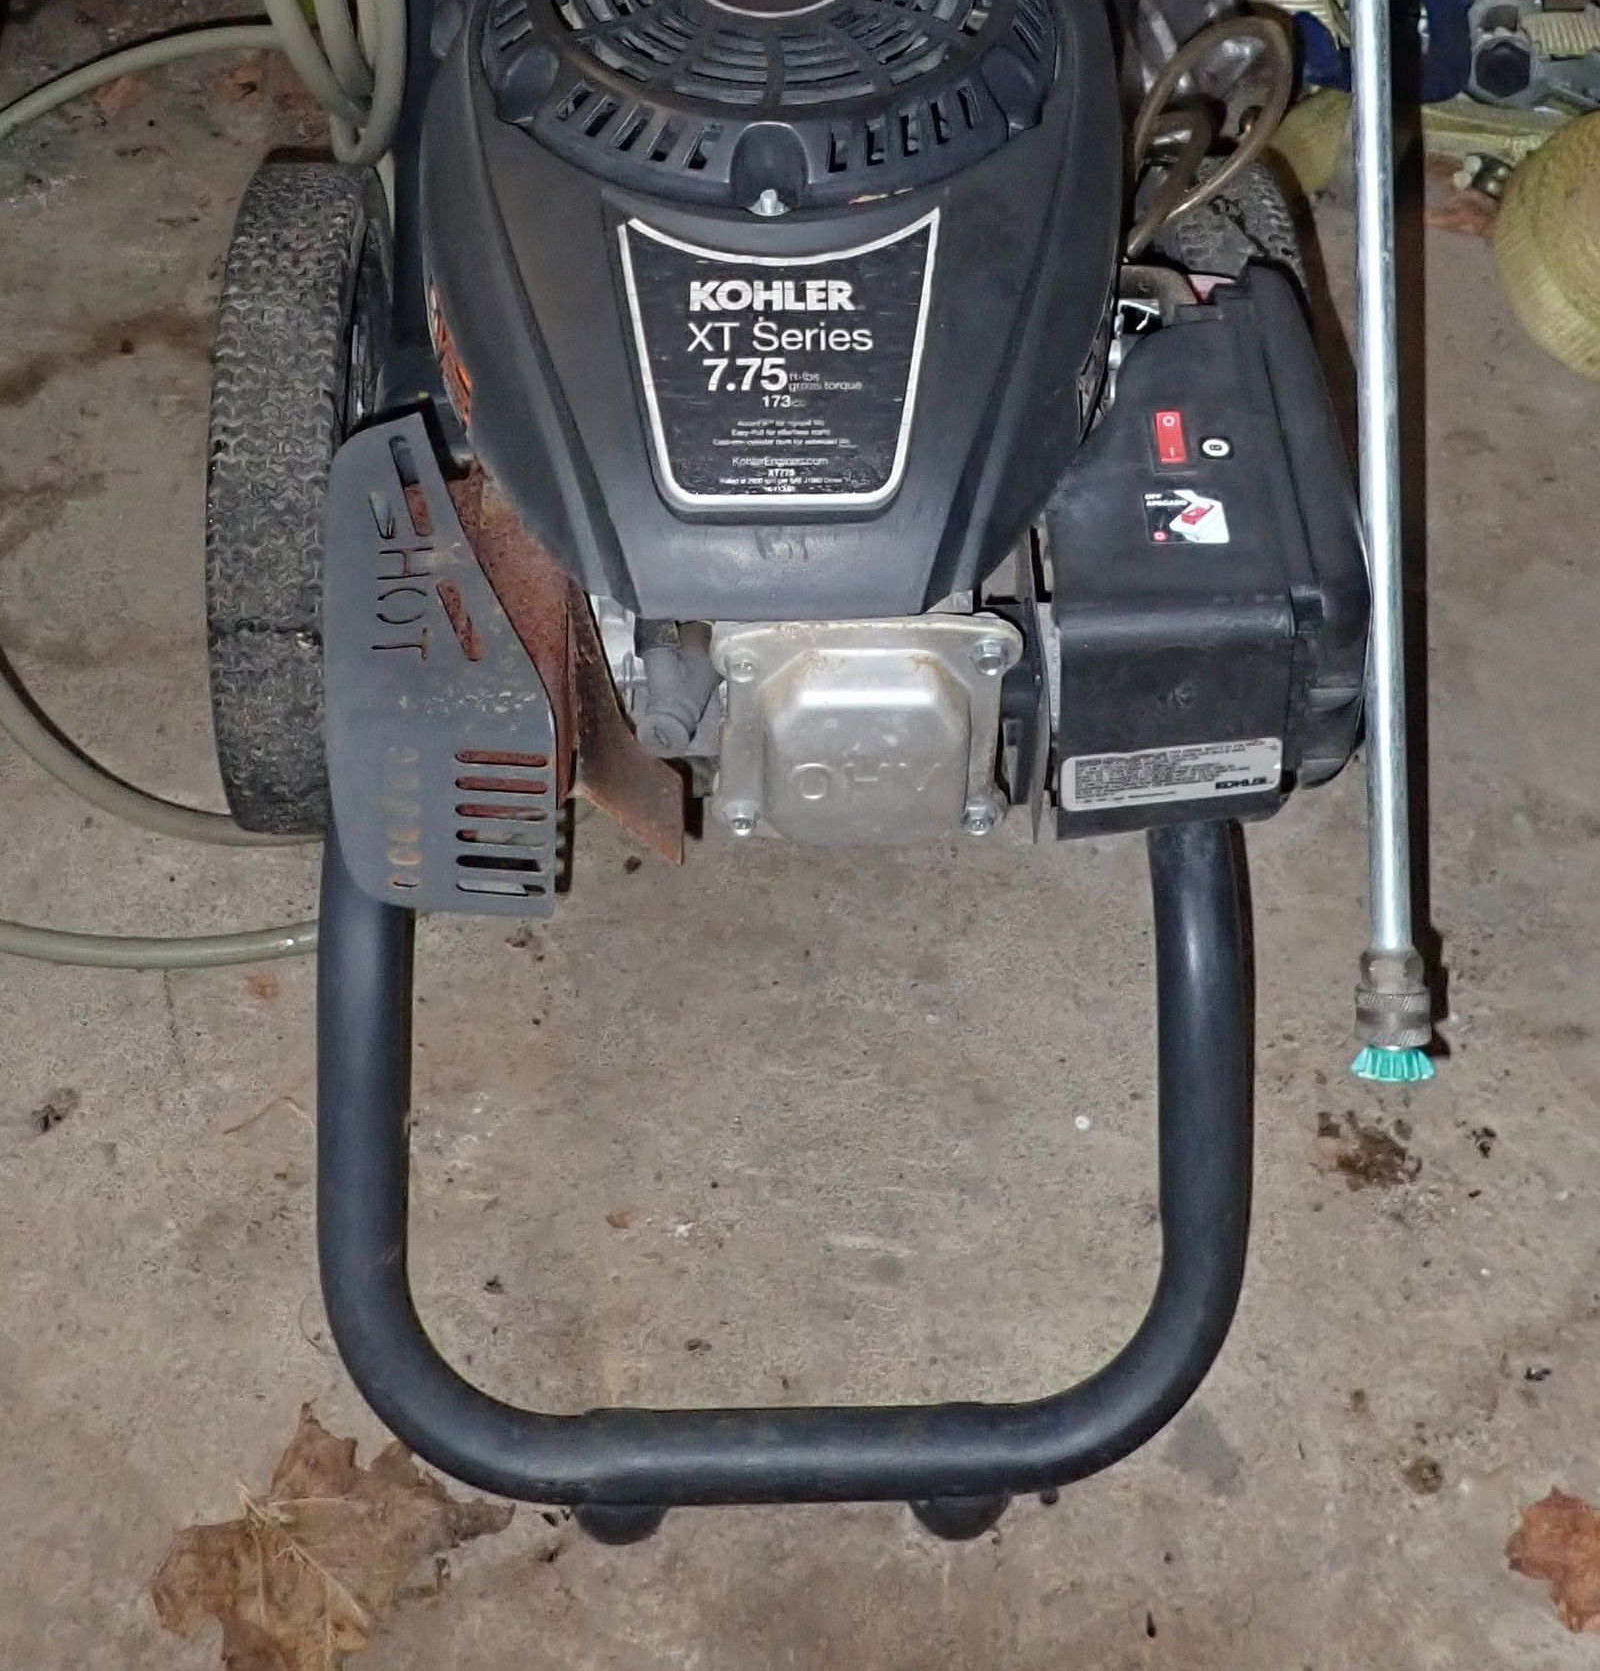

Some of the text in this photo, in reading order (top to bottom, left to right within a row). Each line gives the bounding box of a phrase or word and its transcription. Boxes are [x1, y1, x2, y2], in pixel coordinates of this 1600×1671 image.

[689, 280, 856, 312] KOHLER
[687, 320, 873, 351] XT Series
[703, 358, 788, 391] 7.75
